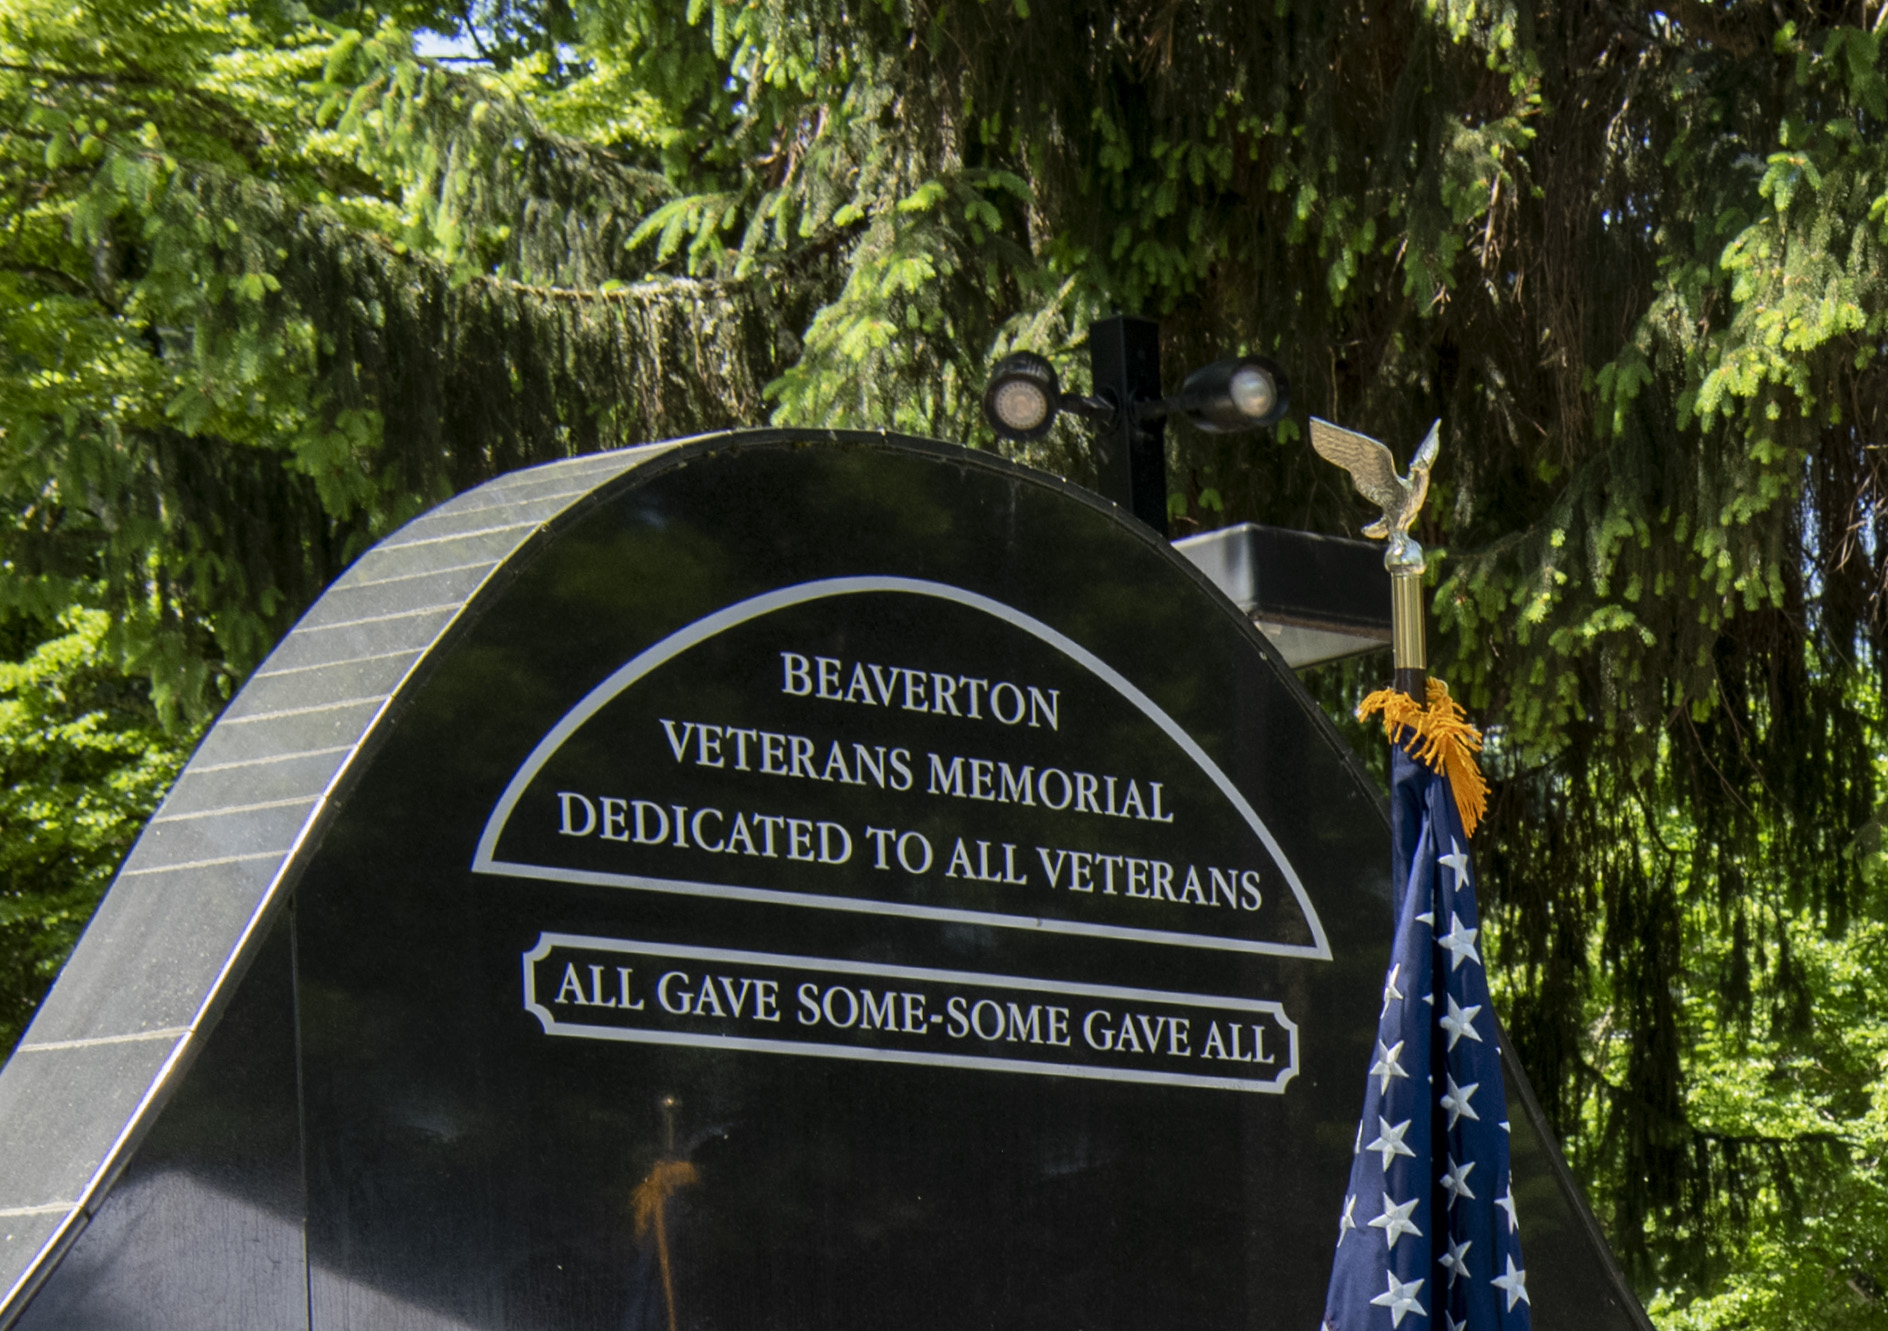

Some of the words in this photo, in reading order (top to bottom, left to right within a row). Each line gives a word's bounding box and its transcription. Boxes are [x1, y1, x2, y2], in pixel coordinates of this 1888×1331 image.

[780, 651, 1060, 731] BEAVERTON
[660, 718, 913, 791] VETERANS
[927, 752, 1175, 823] MEMORIAL
[557, 791, 852, 865] DEDICATED
[866, 824, 933, 875] TO
[945, 837, 1028, 885] ALL
[1035, 847, 1262, 912] VETERANS
[554, 964, 644, 1011] ALL
[657, 970, 780, 1023] GAVE
[796, 983, 1071, 1047] SOME-SOME
[1083, 1009, 1191, 1058] GAVE
[1201, 1021, 1276, 1065] ALL
